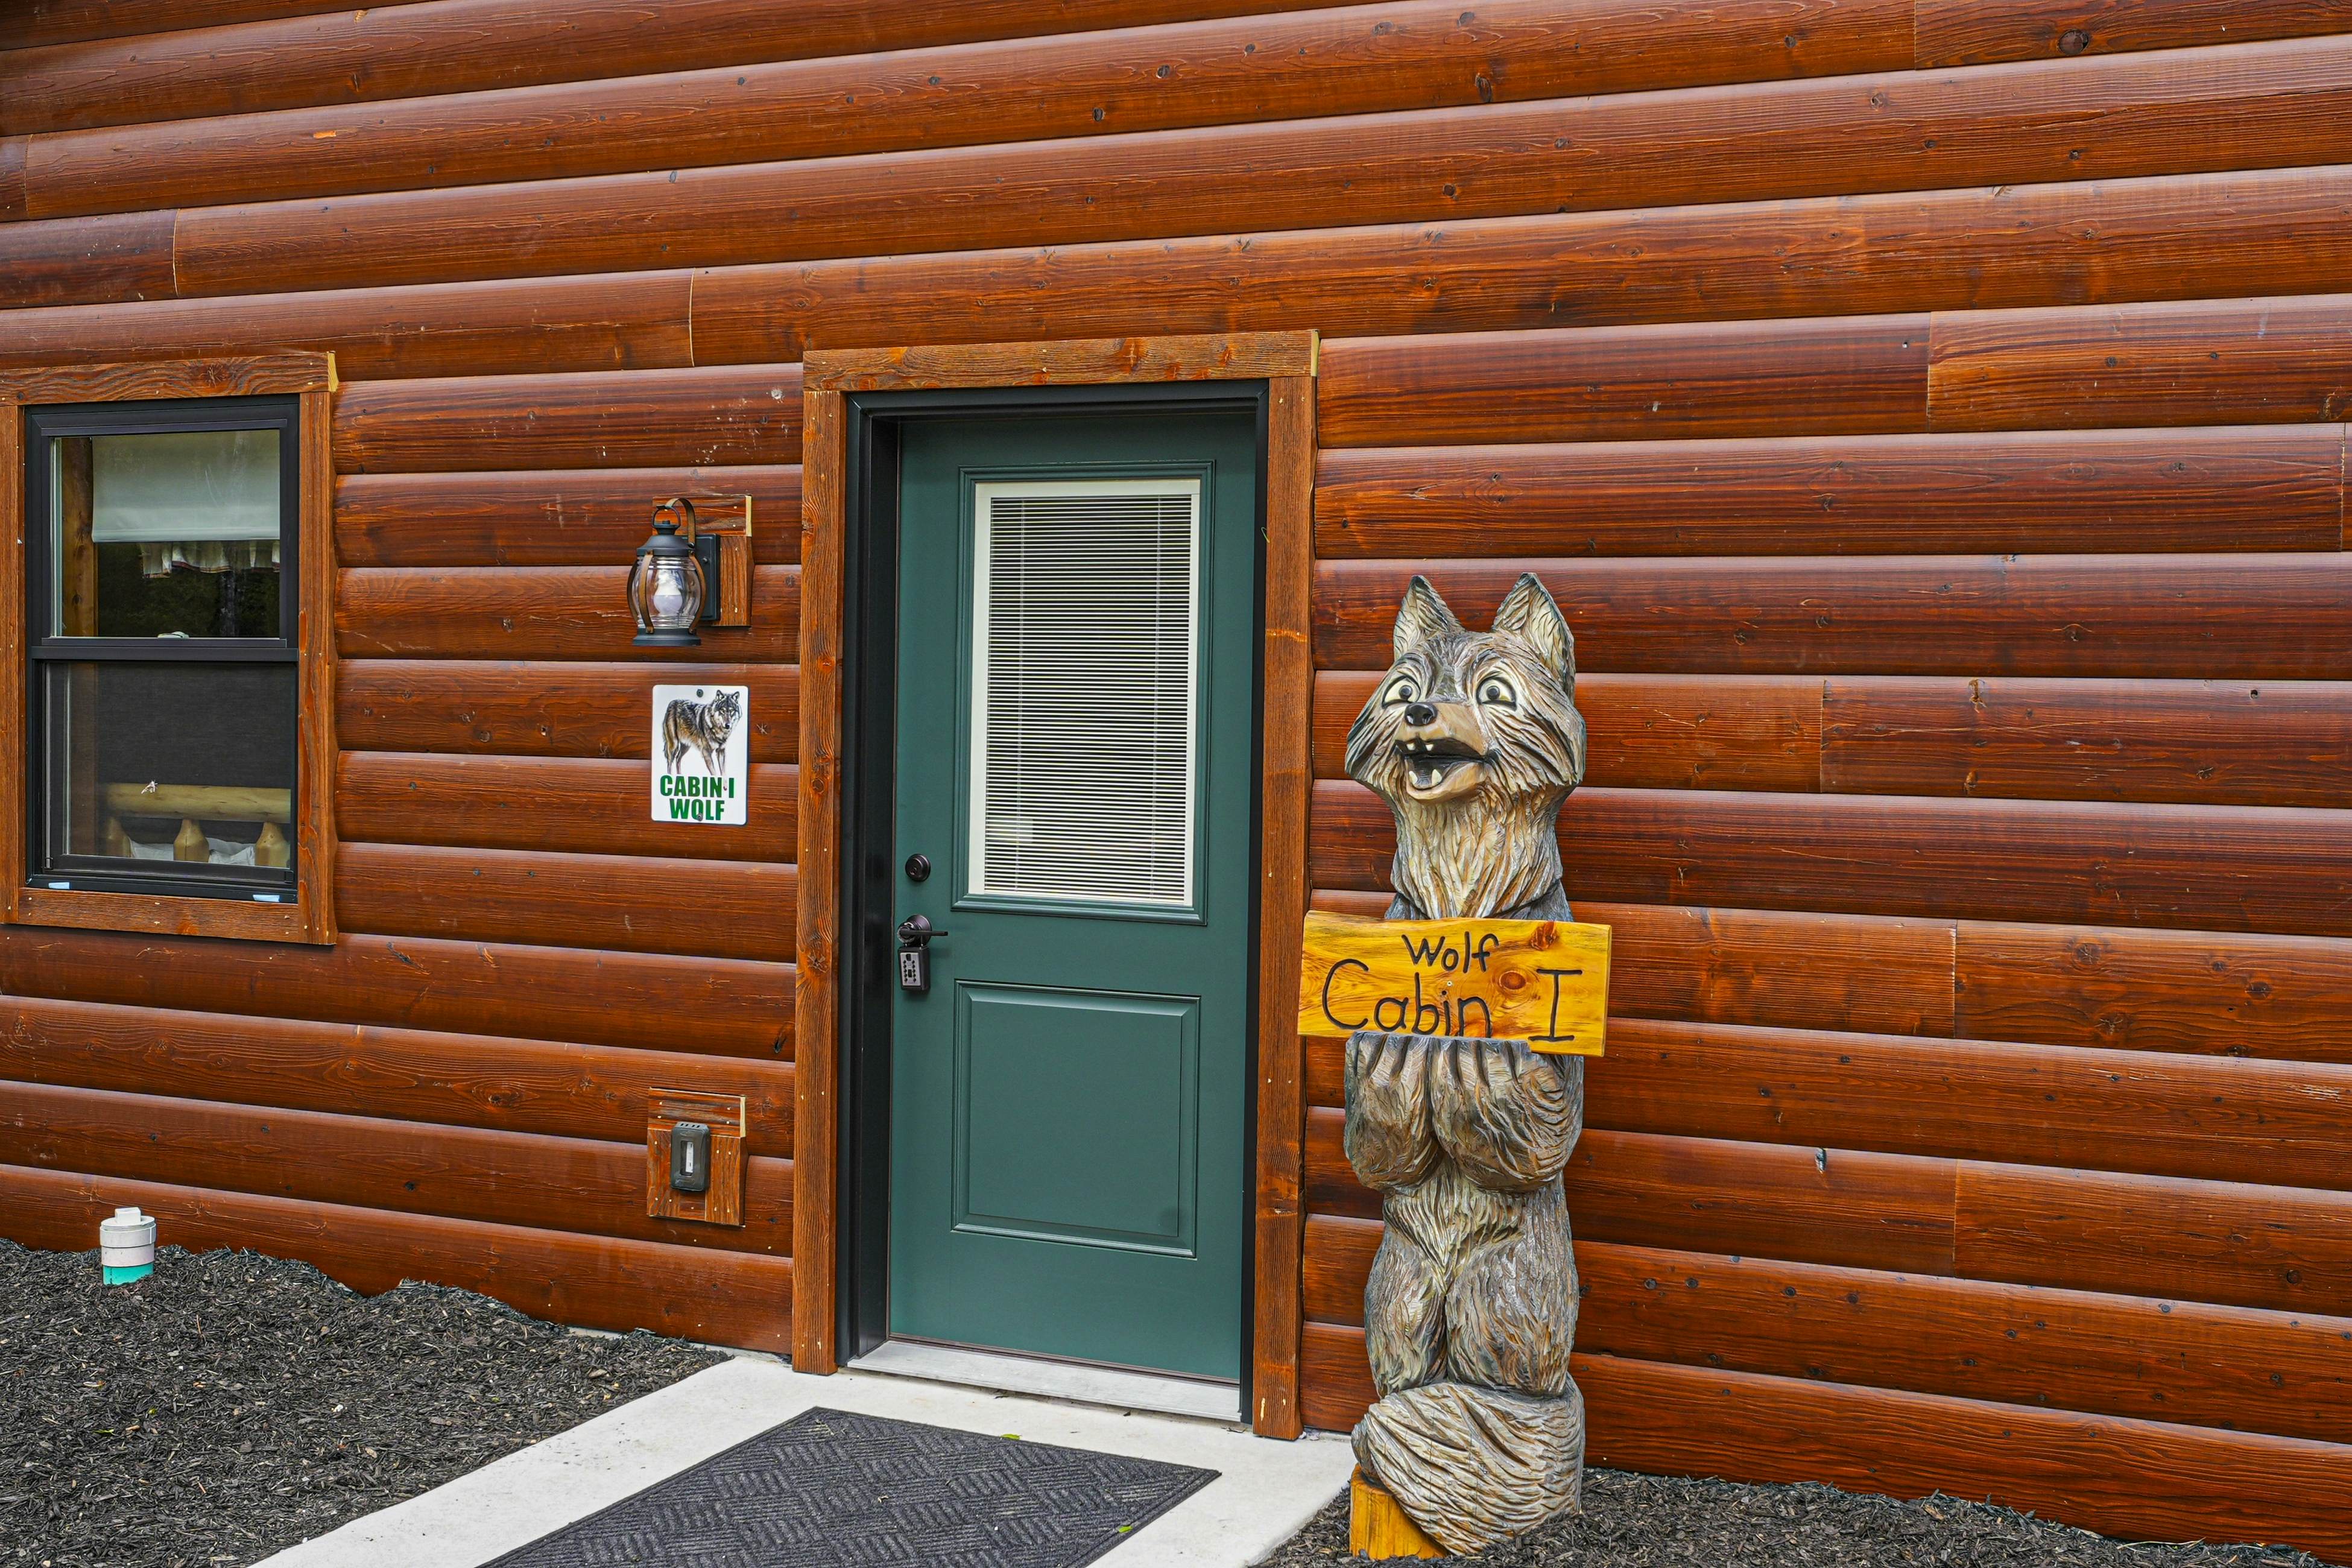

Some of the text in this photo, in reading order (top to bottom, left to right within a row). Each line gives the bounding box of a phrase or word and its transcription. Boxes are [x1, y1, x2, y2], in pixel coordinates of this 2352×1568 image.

[660, 775, 721, 798] CABIN
[670, 798, 725, 821] WOLF
[1402, 931, 1500, 973] Wolf
[1322, 958, 1582, 1042] Cabin I
